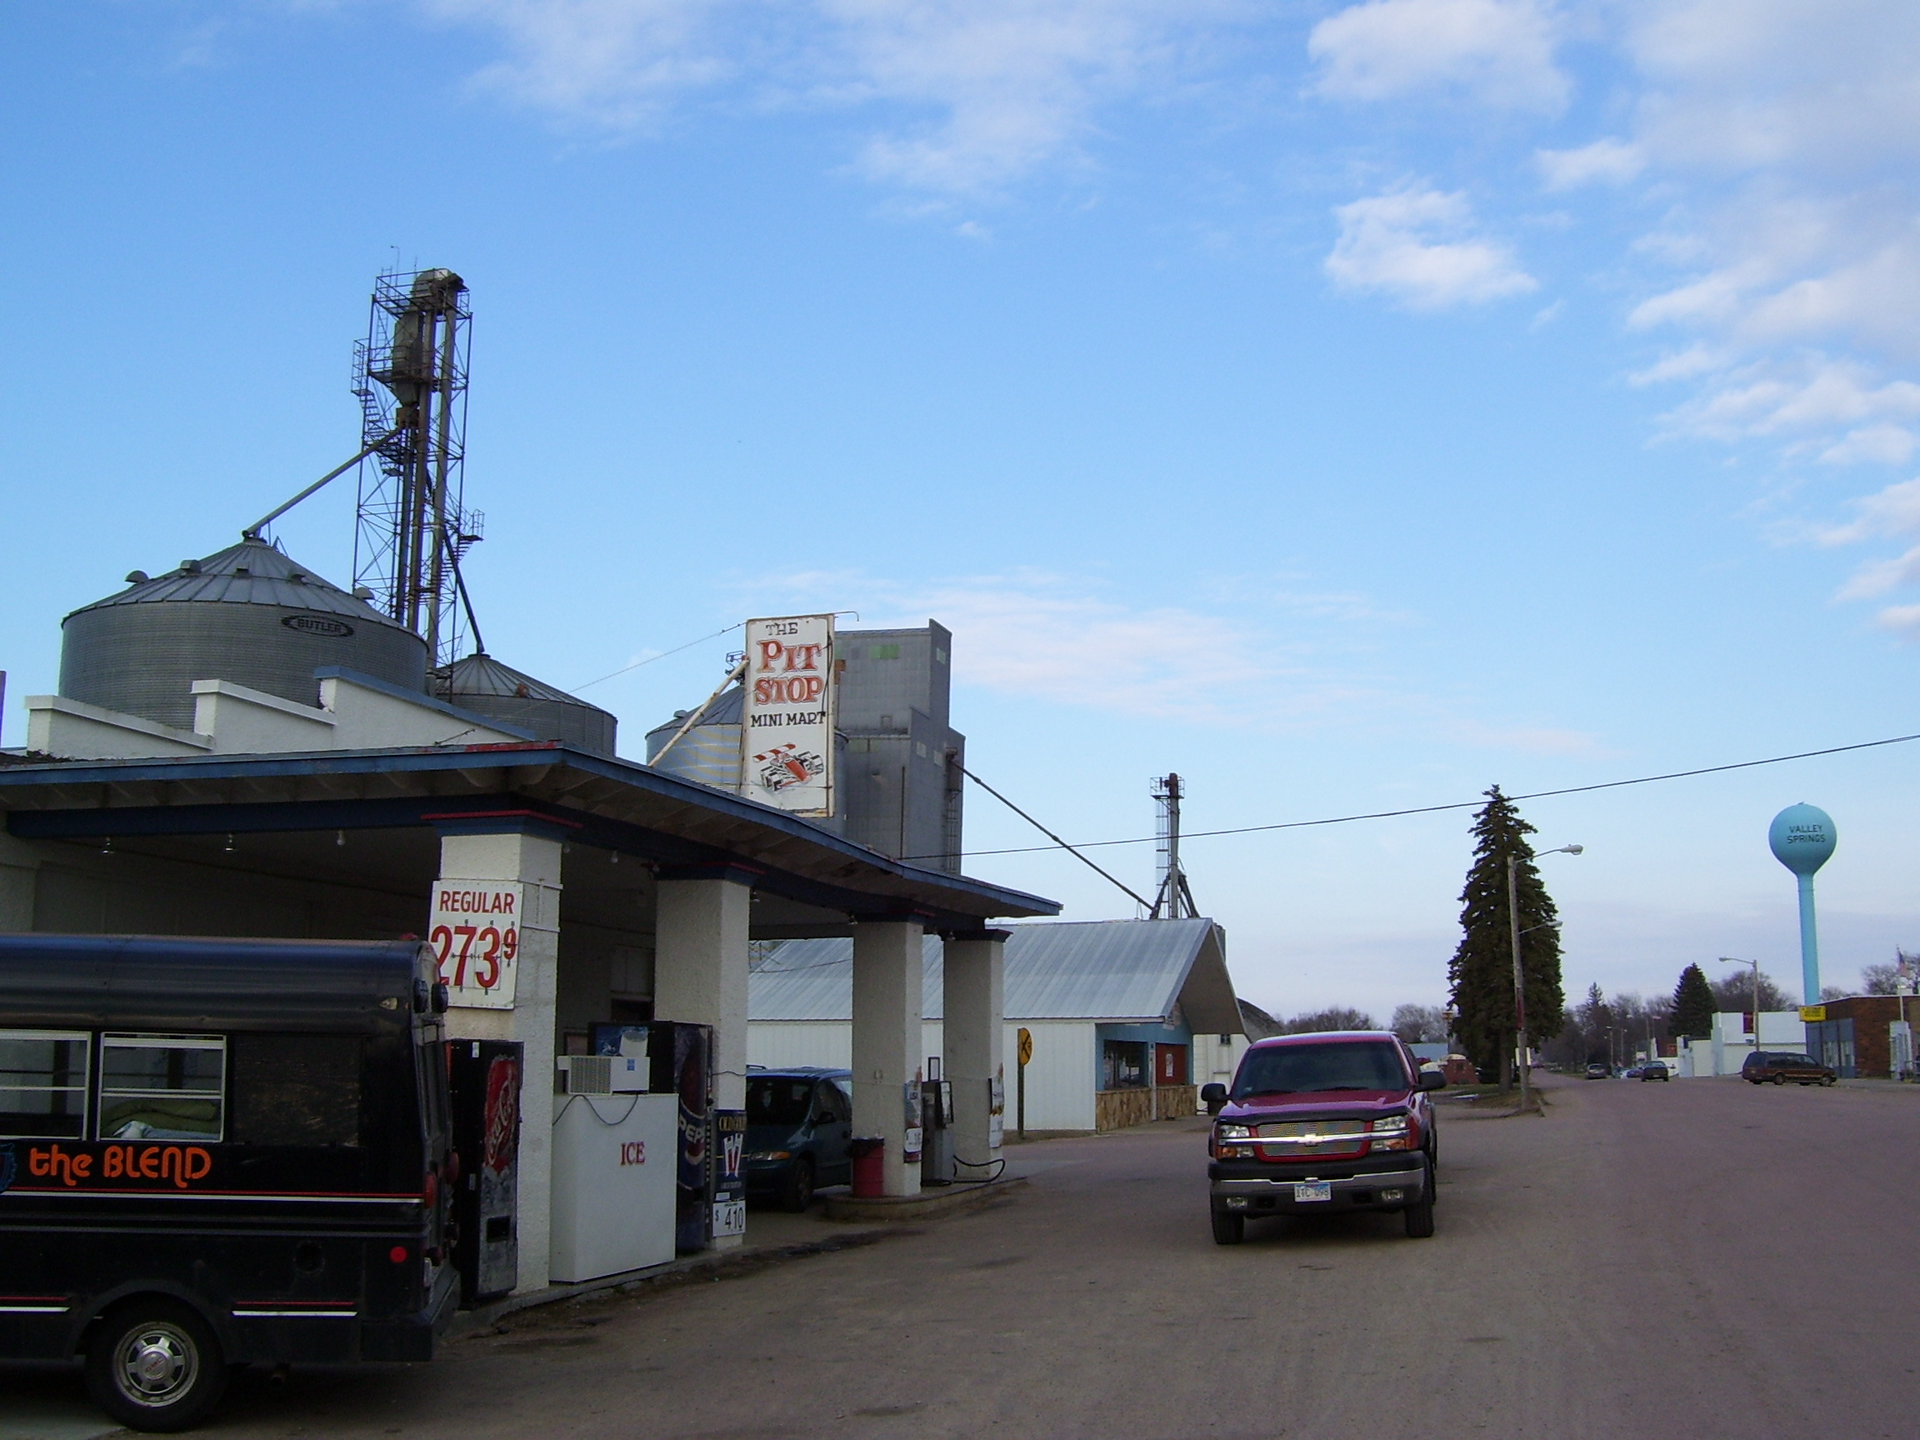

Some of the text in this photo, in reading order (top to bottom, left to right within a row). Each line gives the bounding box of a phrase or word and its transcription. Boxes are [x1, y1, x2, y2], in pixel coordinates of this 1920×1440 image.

[298, 618, 341, 633] BUTLER
[766, 622, 798, 635] THE
[756, 639, 822, 673] PIT
[754, 675, 823, 705] STOP
[751, 712, 826, 728] MINI MART
[1789, 824, 1823, 833] VALLEY
[1787, 834, 1825, 844] SPRINGS
[439, 890, 515, 914] REGULAR
[620, 1141, 646, 1166] ICE
[29, 1144, 212, 1188] the BLEND
